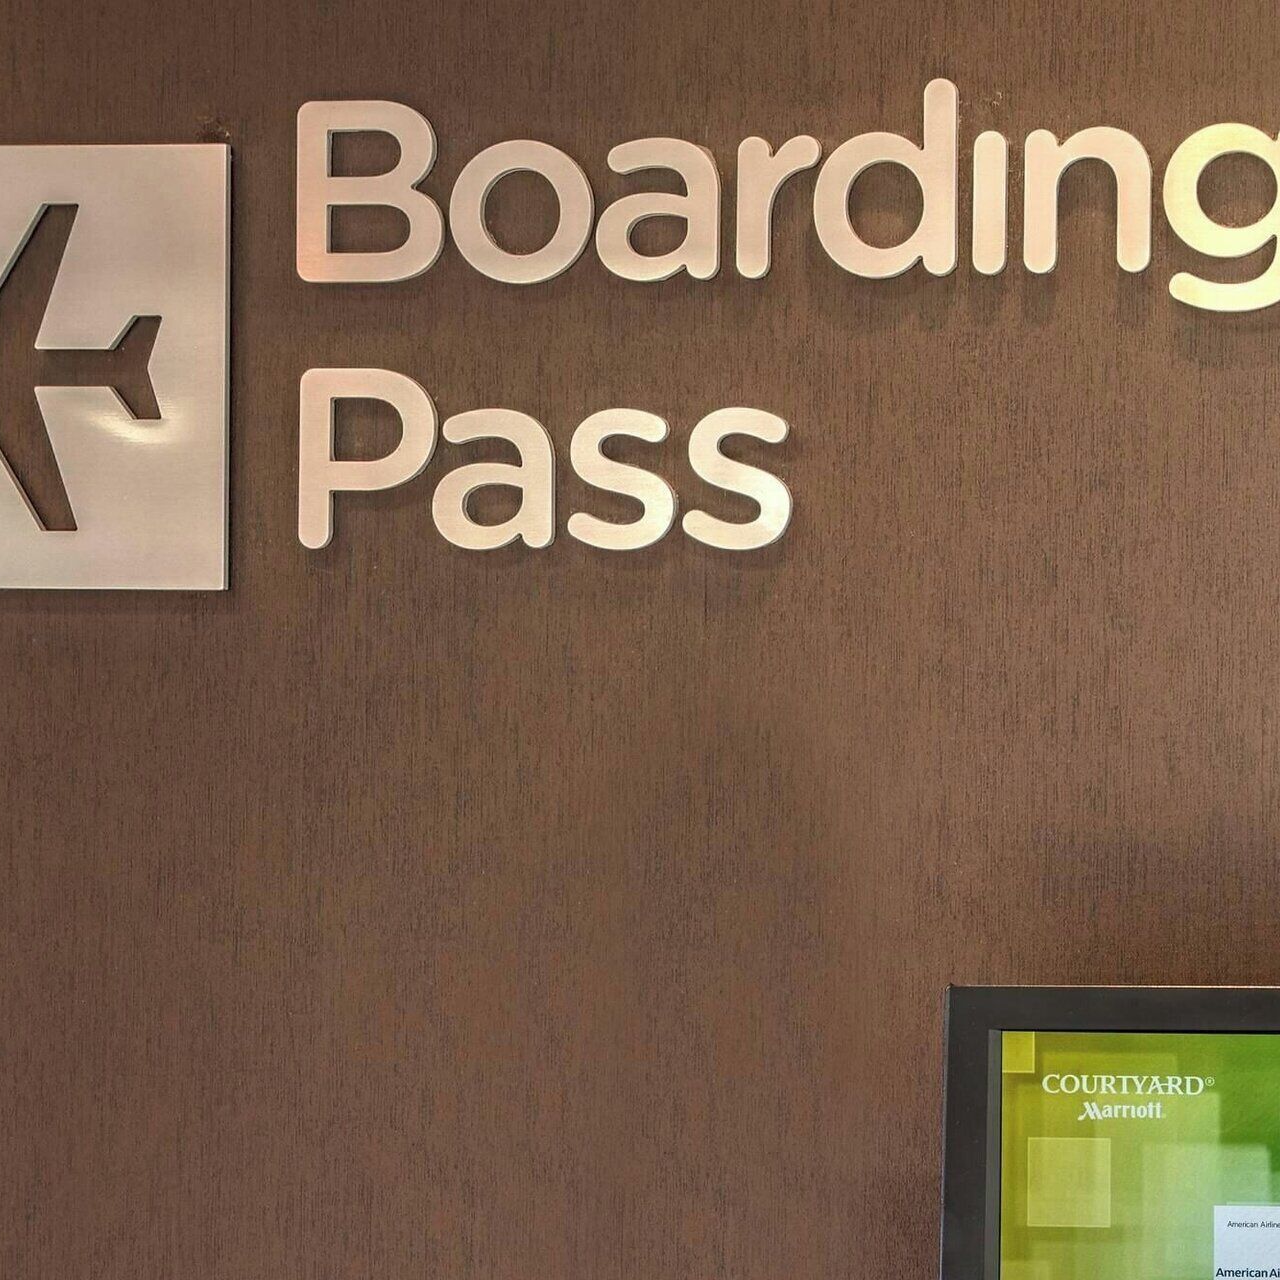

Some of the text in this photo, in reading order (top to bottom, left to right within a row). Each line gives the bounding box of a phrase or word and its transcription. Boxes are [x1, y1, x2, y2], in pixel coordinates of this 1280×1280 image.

[299, 368, 792, 551] Pass
[1077, 1101, 1164, 1121] Marriott
[1227, 1220, 1258, 1228] American
[1215, 1267, 1268, 1279] American
